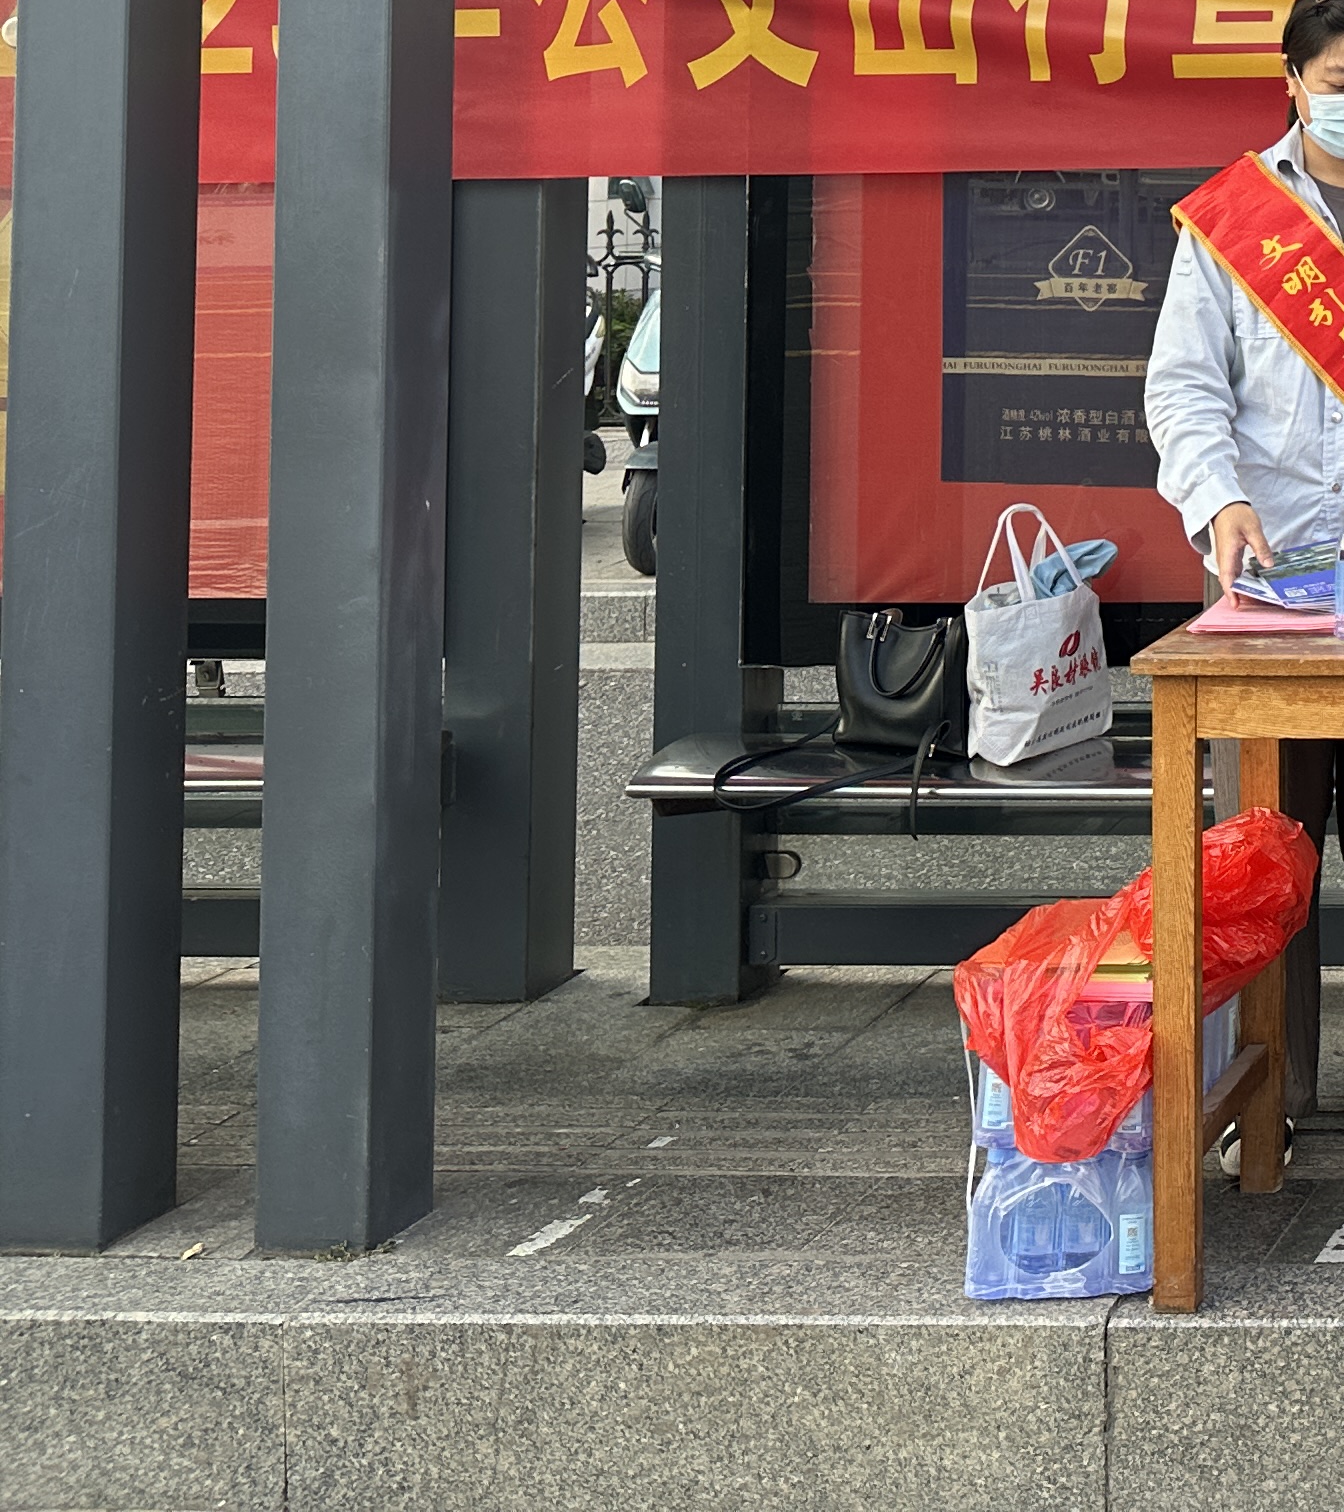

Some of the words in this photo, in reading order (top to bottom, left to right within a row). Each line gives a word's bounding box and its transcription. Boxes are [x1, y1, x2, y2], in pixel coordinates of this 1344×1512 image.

[1069, 249, 1108, 275] F1
[963, 361, 1042, 372] FURUDONGHAI
[1049, 363, 1130, 373] FURUDONGHAI
